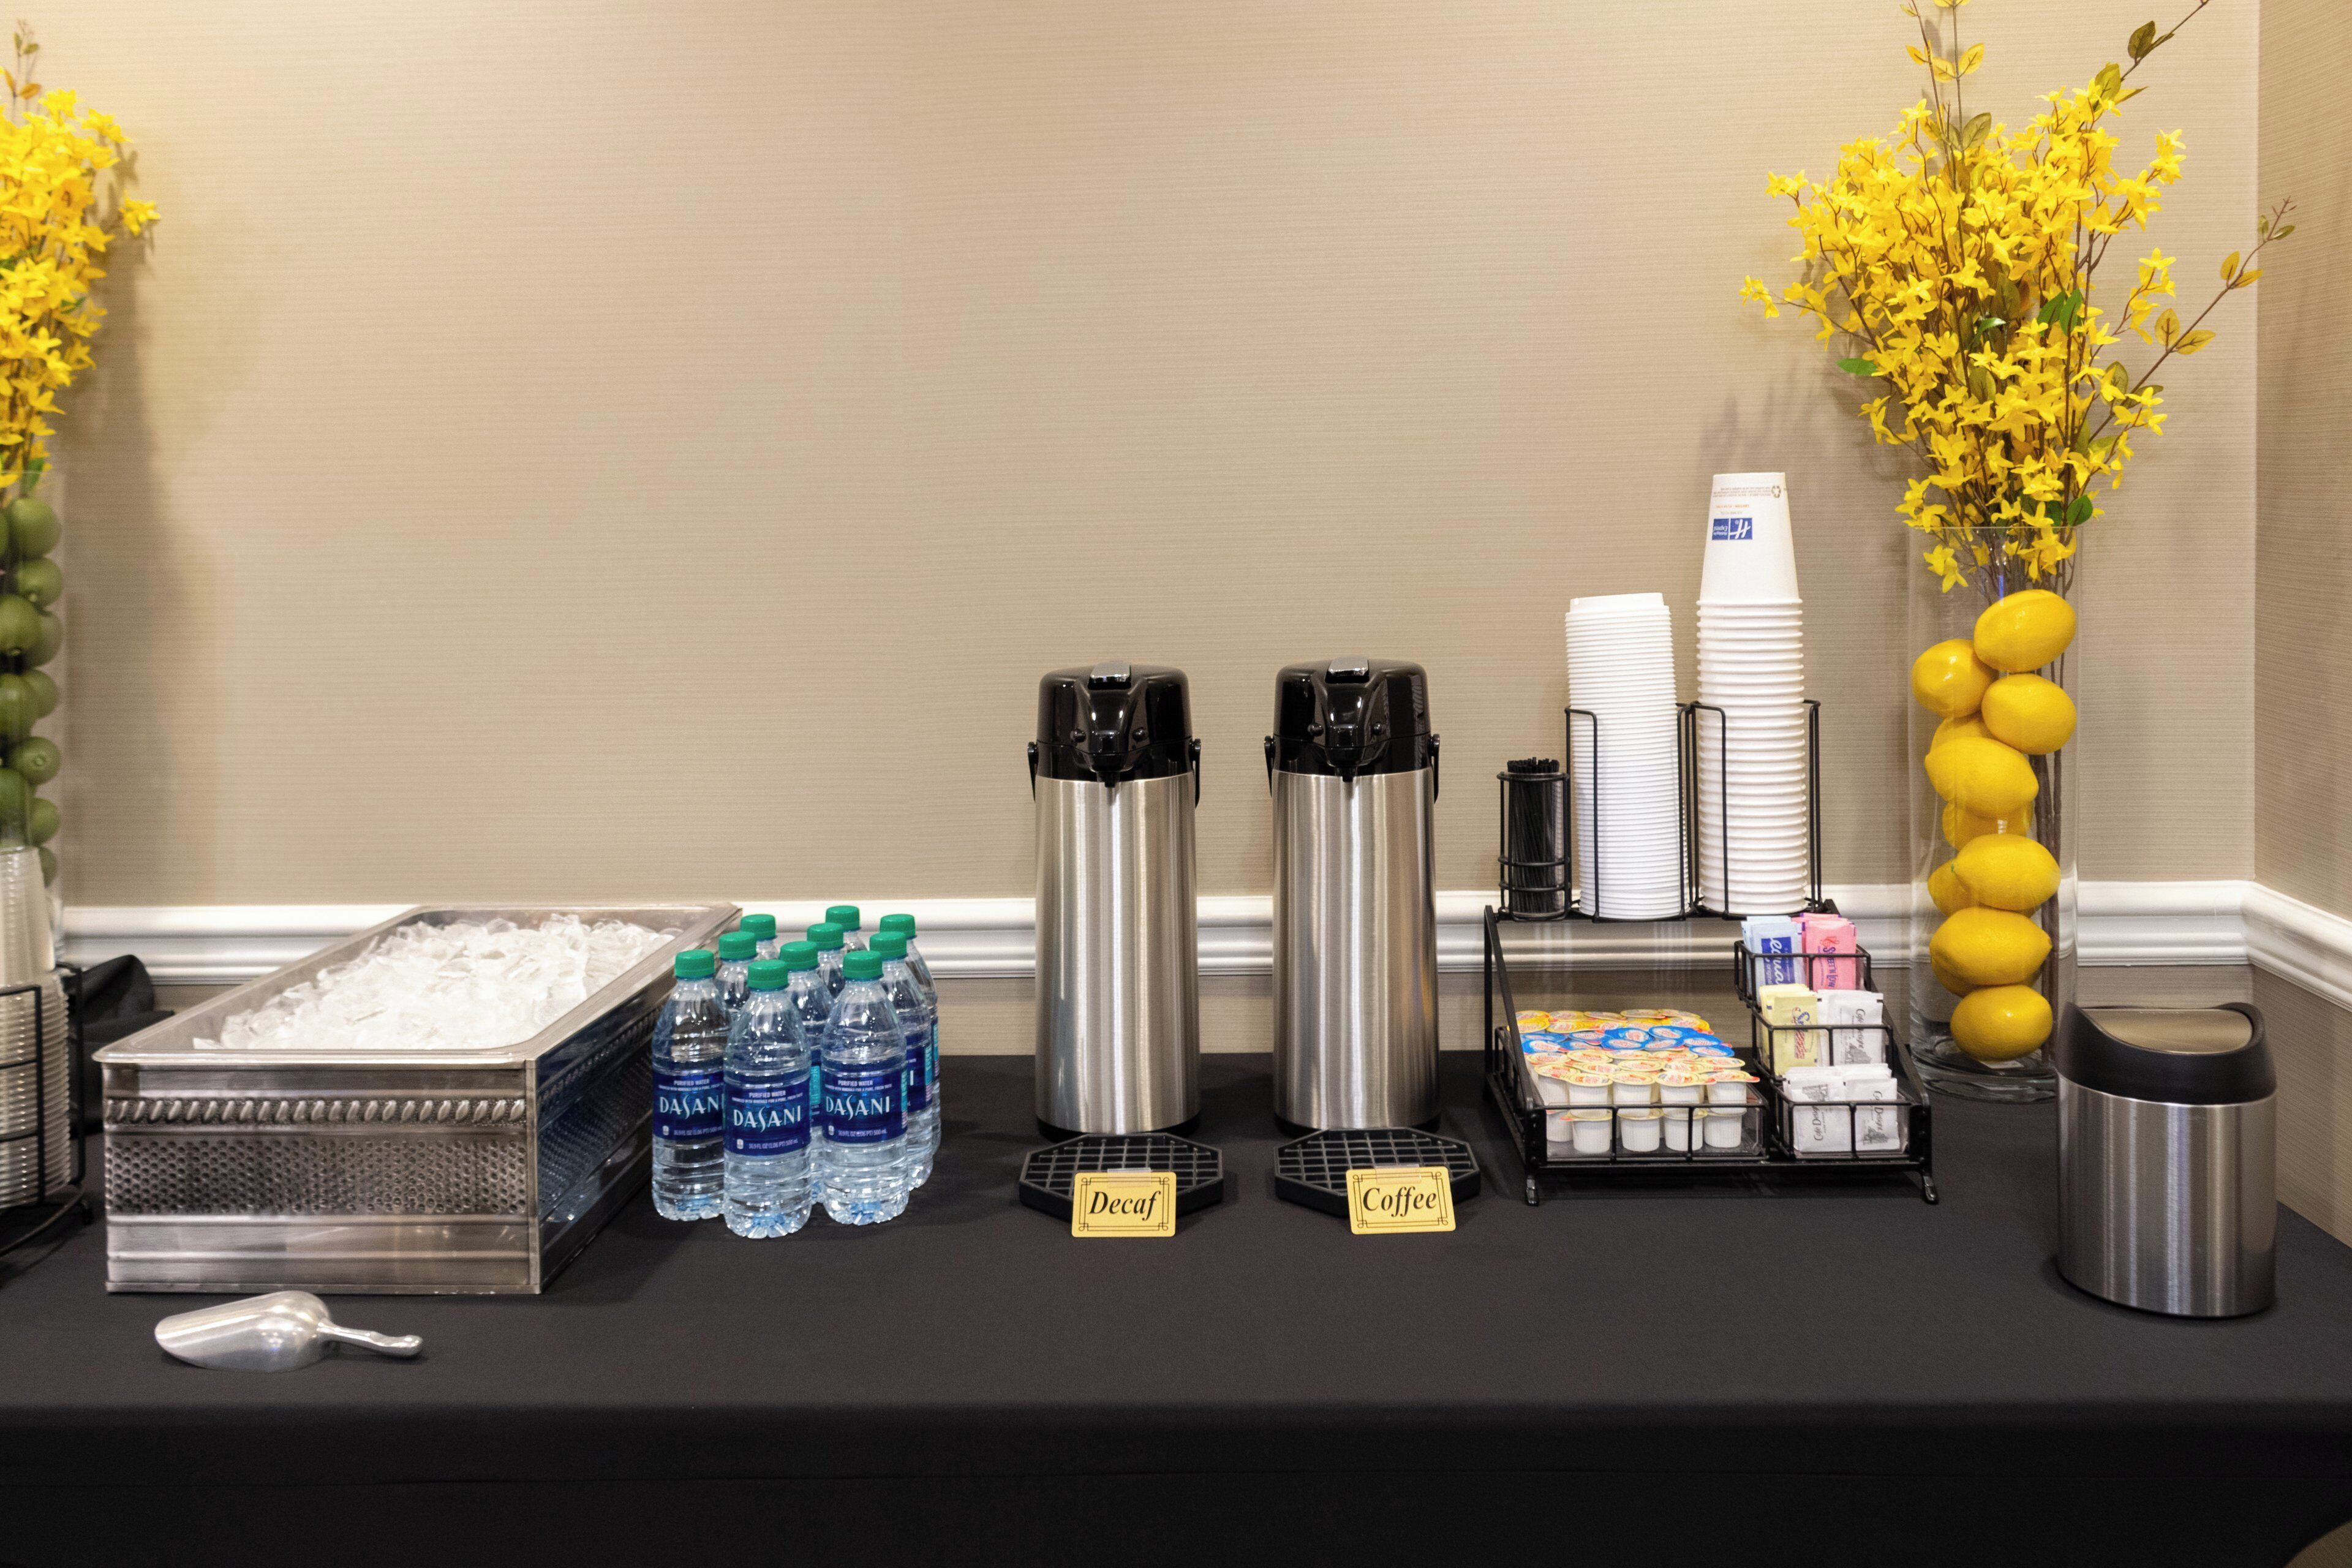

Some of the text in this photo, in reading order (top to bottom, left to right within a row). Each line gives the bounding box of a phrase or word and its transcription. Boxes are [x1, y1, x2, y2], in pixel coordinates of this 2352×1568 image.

[1765, 938, 1784, 985] equa
[734, 1105, 801, 1133] DASANI
[826, 1095, 890, 1120] DASANI
[1089, 1191, 1161, 1221] Decaf
[1363, 1186, 1436, 1217] Coffee
